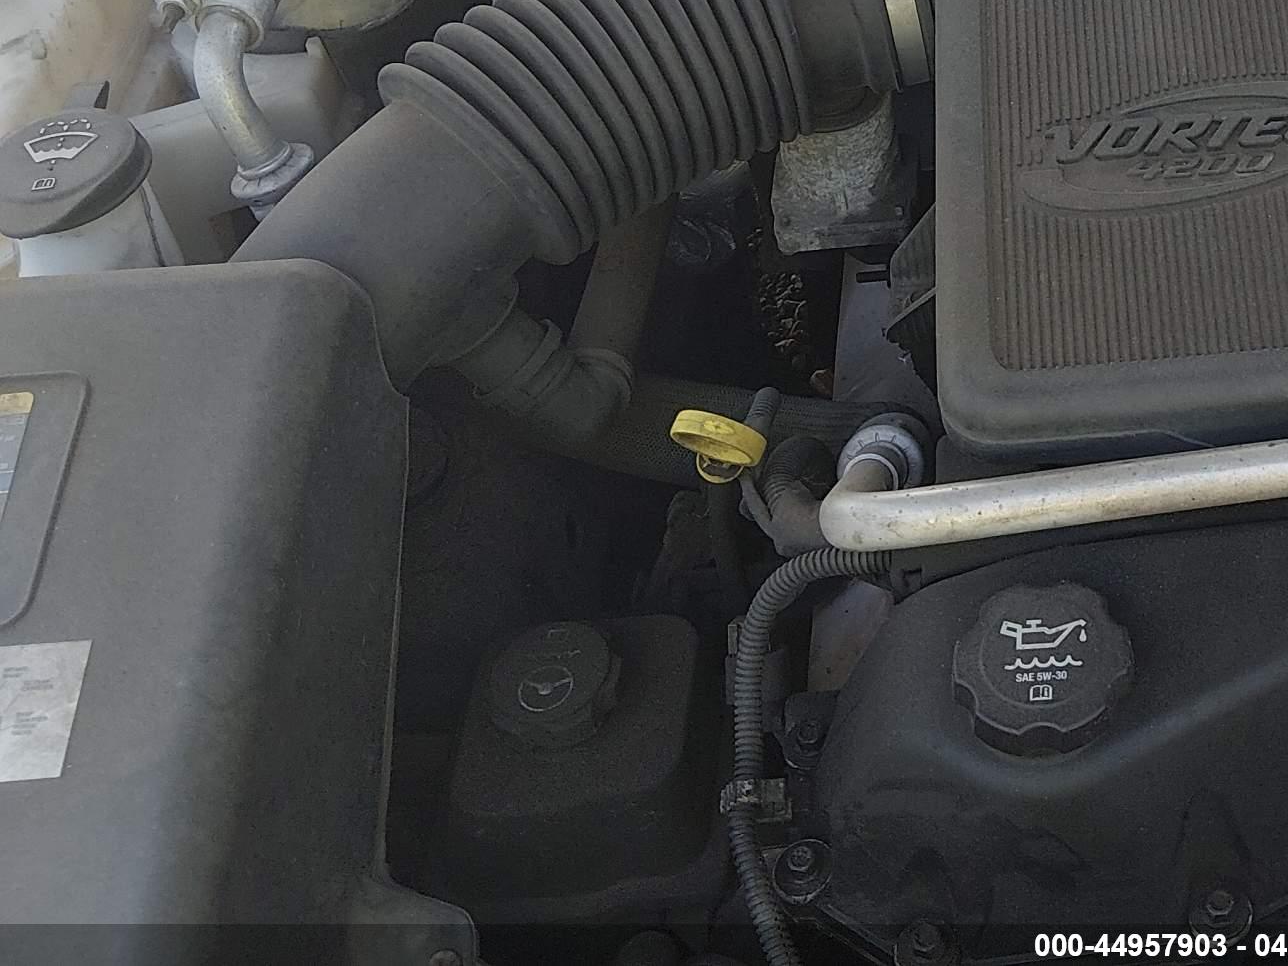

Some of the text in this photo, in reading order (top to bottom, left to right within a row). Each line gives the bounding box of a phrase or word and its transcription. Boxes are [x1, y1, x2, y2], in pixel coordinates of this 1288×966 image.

[1128, 152, 1275, 180] 4200
[1016, 670, 1067, 682] SAE 5W-30
